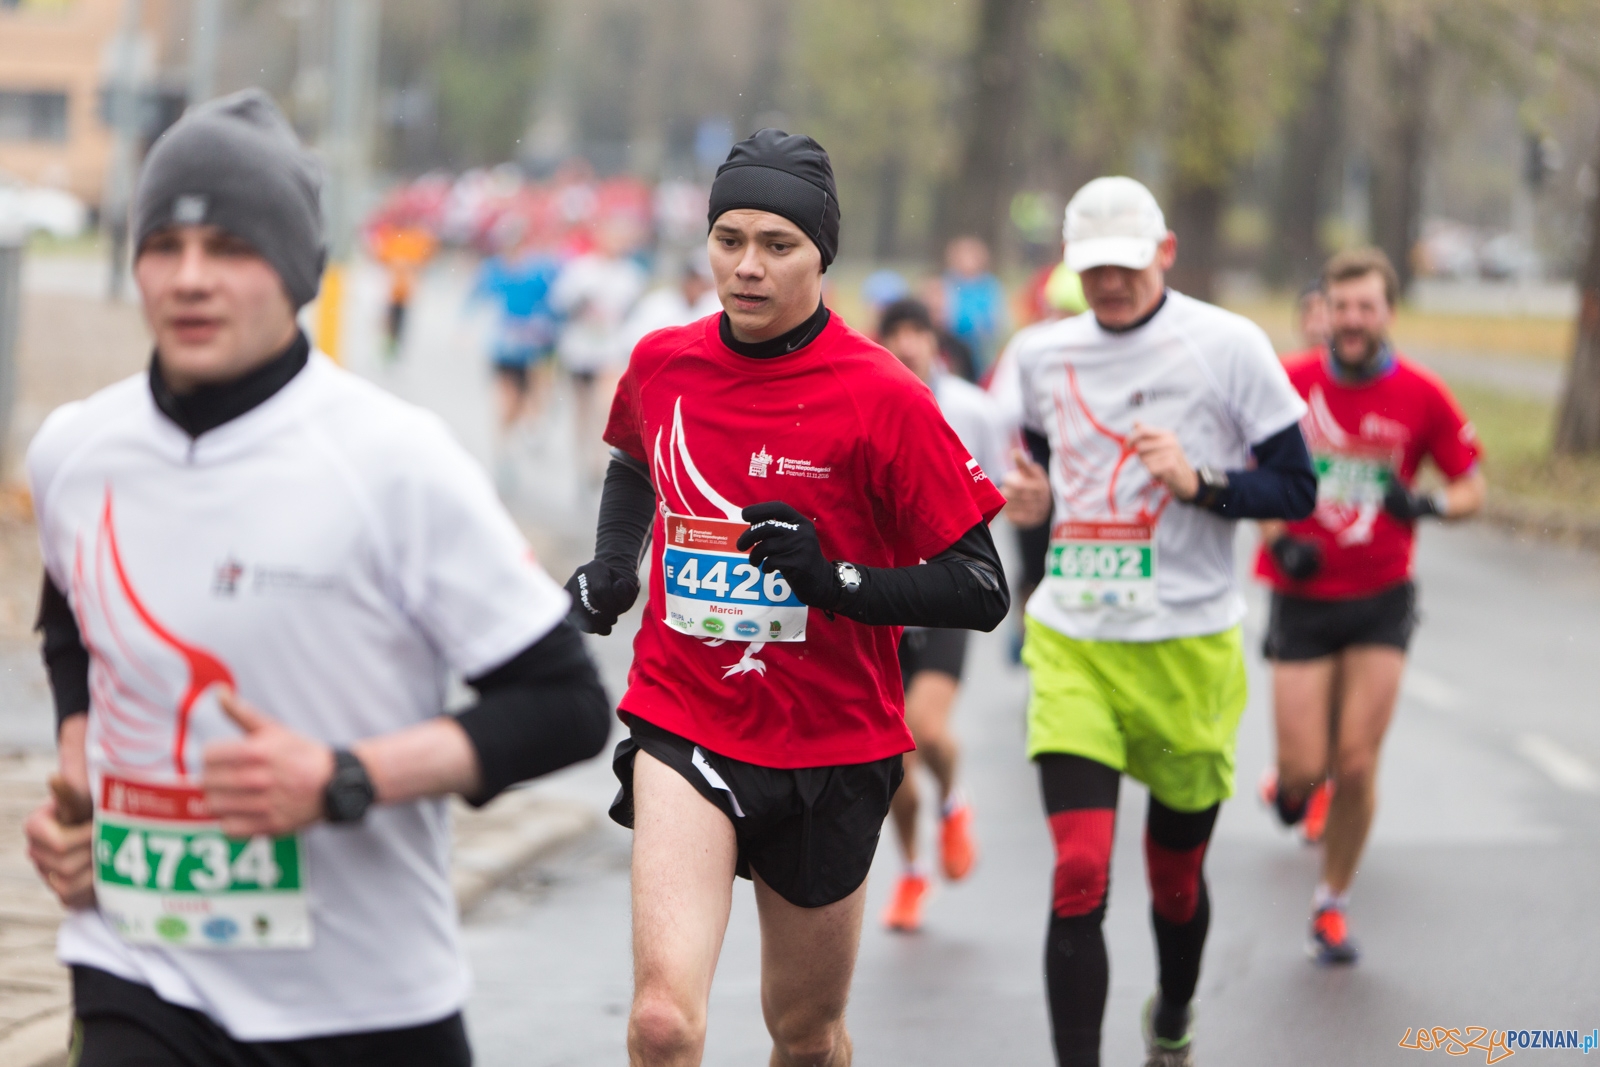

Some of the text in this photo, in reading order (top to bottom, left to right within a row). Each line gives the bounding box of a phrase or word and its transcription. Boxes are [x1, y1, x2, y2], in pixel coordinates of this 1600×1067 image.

[776, 457, 785, 475] 1
[1060, 545, 1142, 577] 6902
[666, 557, 792, 603] E 4426
[709, 604, 744, 616] Marcin
[113, 829, 282, 890] 4734
